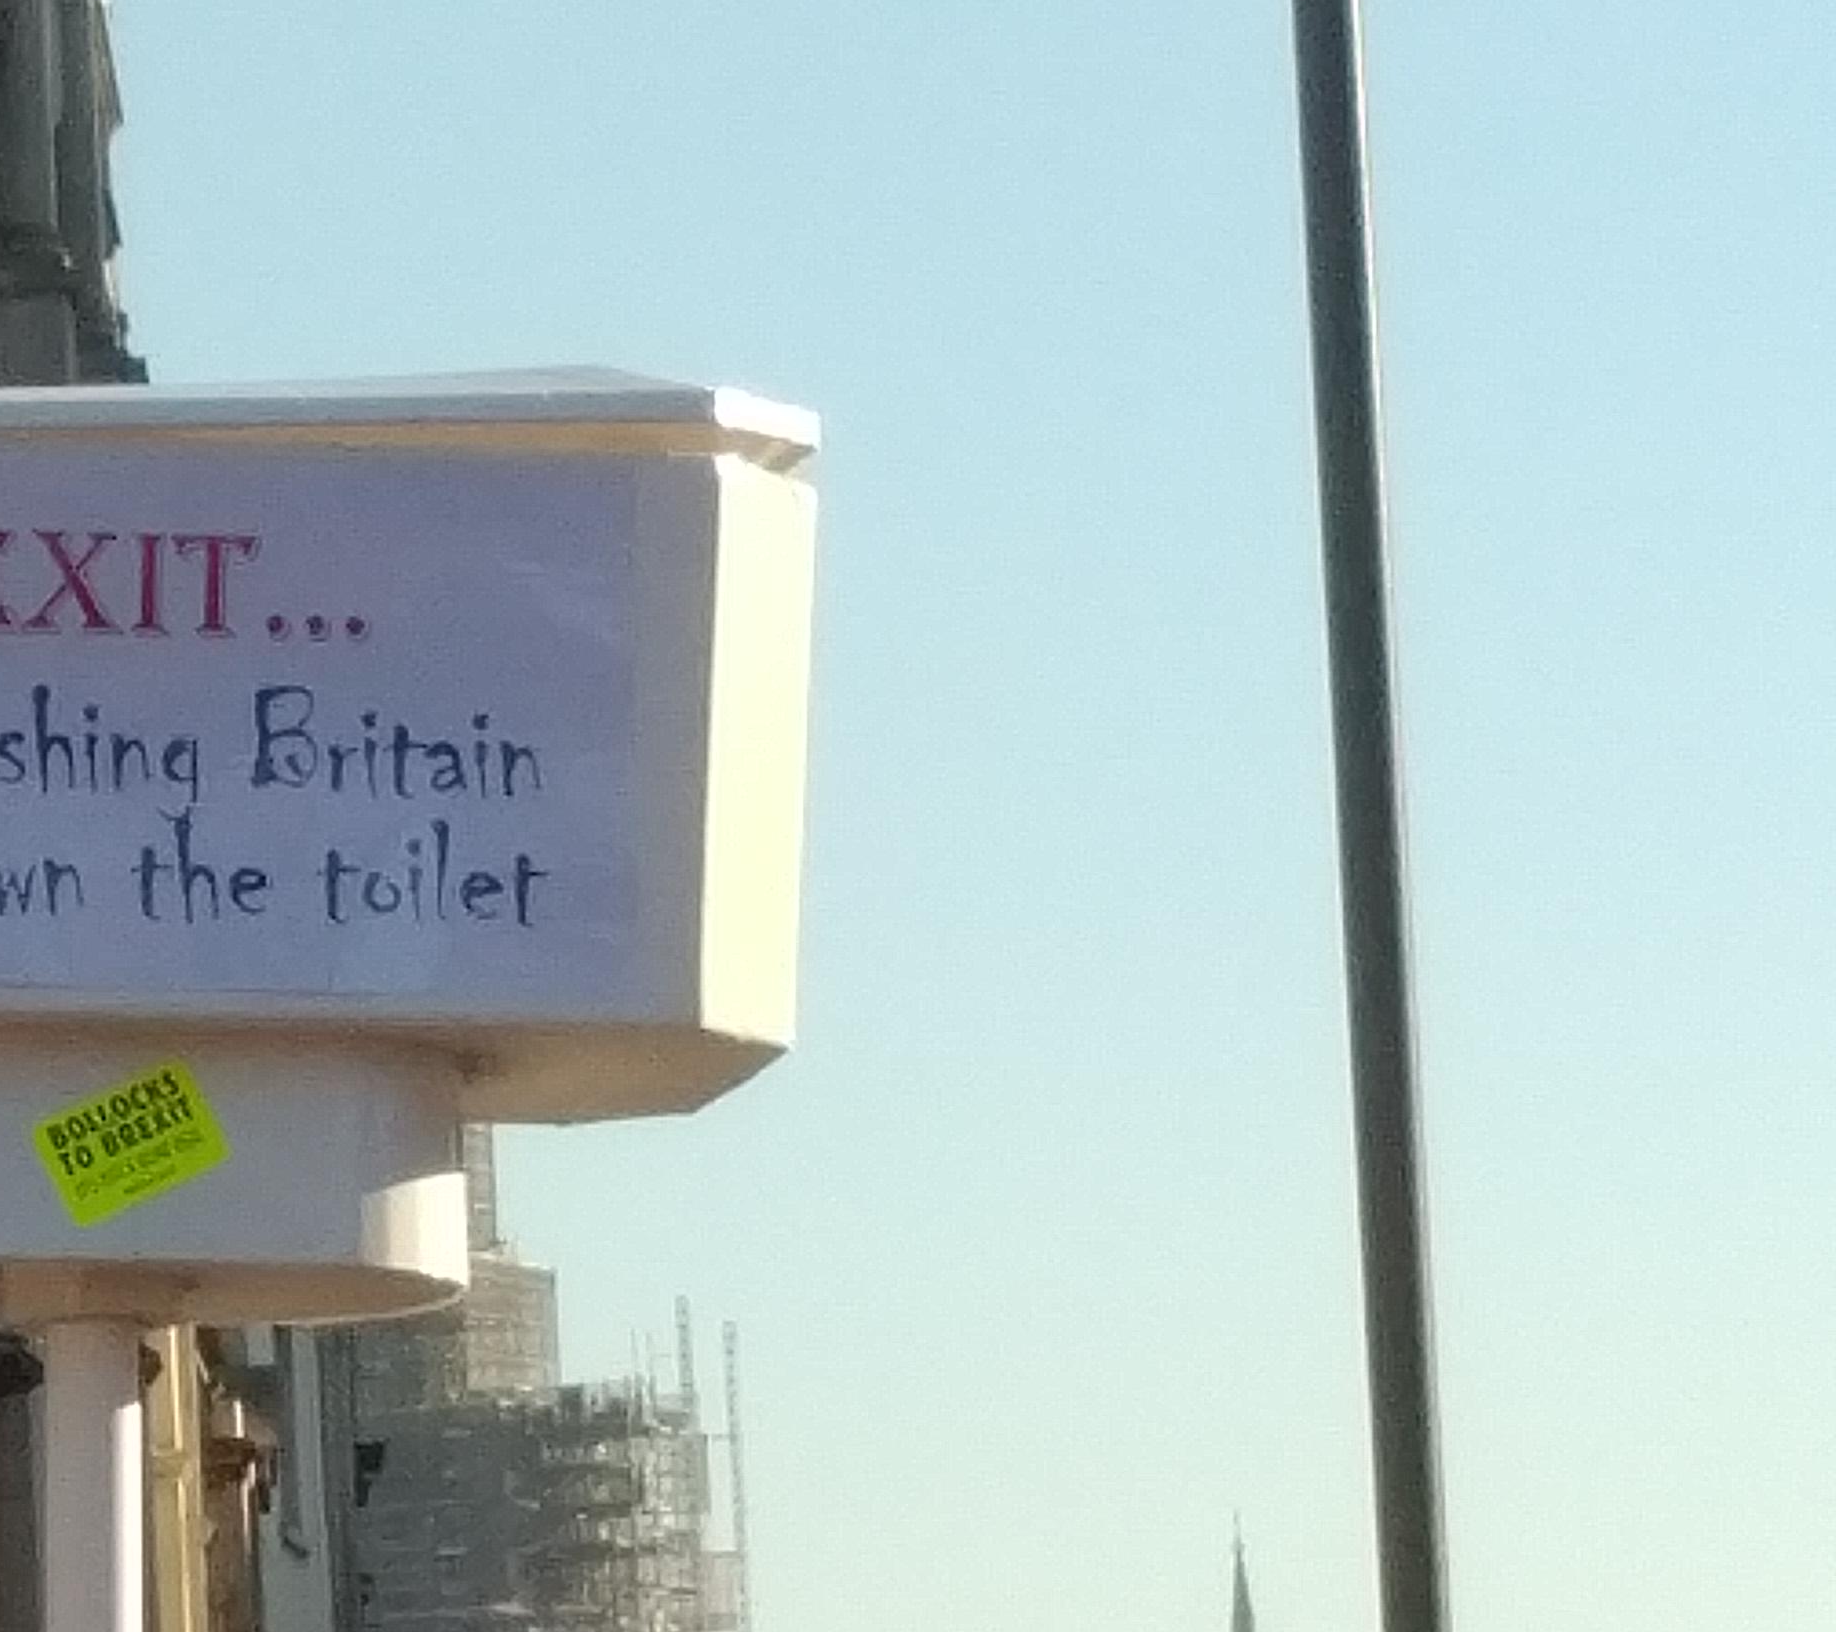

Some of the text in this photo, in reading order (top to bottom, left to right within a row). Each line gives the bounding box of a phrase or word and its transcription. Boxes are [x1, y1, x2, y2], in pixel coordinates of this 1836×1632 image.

[250, 684, 547, 797] Britain
[130, 809, 271, 924] the
[318, 819, 549, 927] toilet
[46, 1070, 180, 1150] BOLLOCKS
[57, 1145, 95, 1177] TO
[100, 1094, 194, 1158] BREXIT
